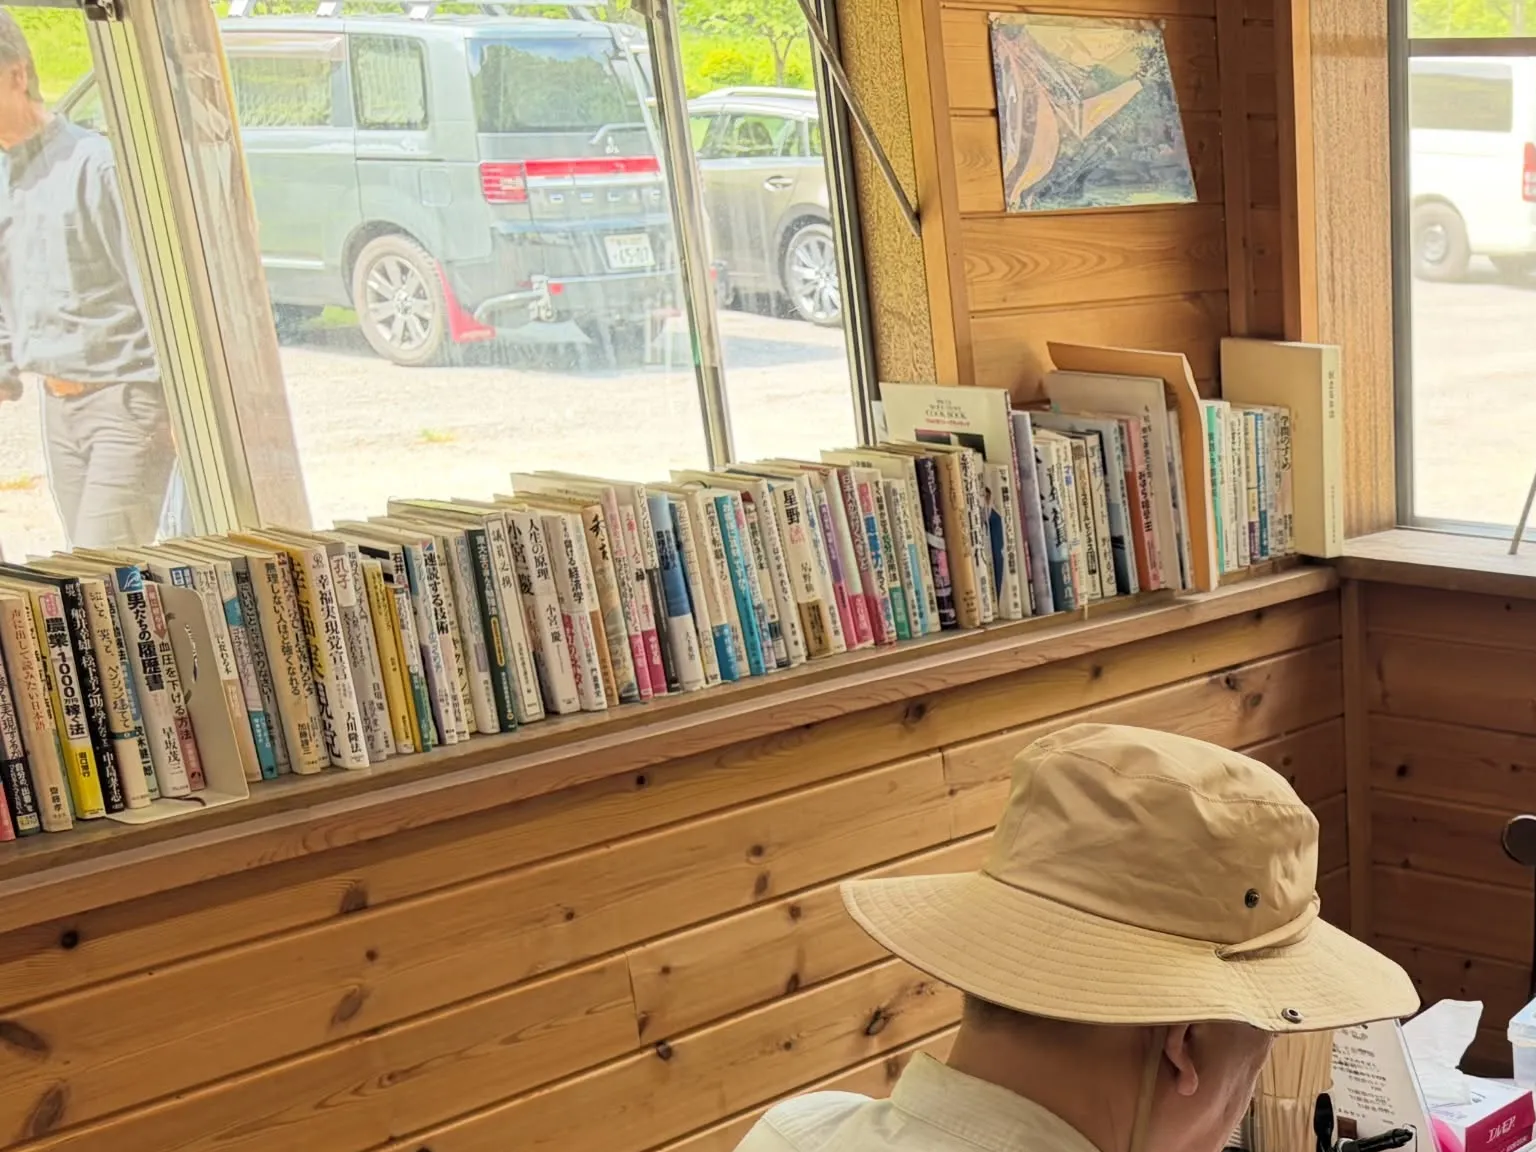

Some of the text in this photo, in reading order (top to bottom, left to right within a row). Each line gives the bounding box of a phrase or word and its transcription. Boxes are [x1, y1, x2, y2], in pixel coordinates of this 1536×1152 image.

[333, 557, 348, 589] 孔子
[126, 591, 165, 692] 男たちの履歴書
[159, 641, 192, 740] 血圧を下げる方法
